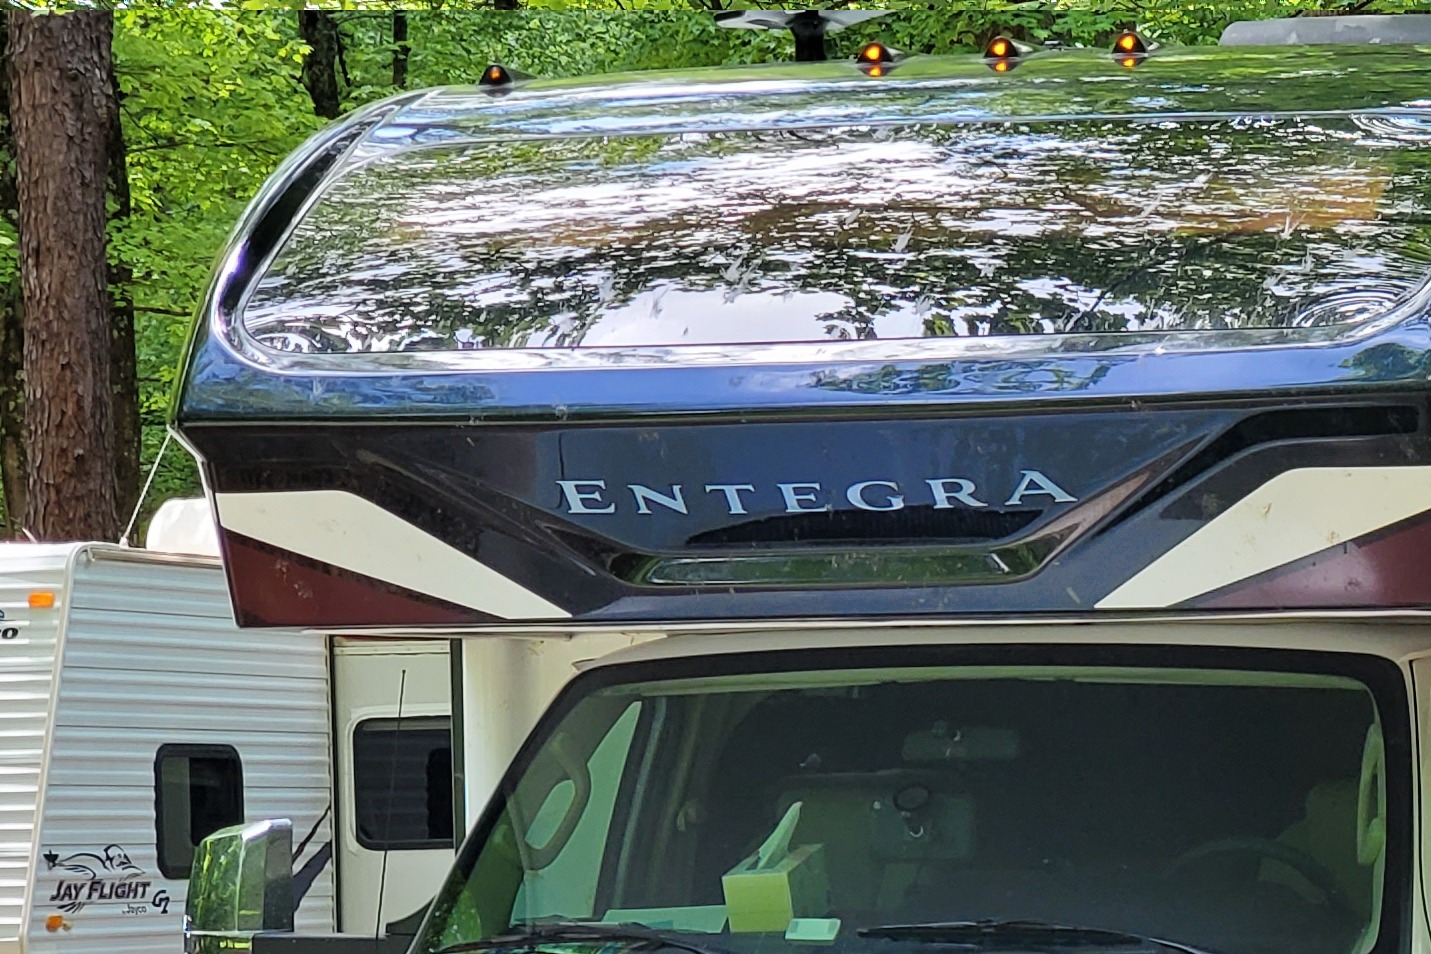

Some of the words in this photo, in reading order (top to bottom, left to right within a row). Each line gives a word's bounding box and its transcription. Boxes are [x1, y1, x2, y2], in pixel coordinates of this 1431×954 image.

[555, 469, 1079, 515] ENTEGRA
[49, 880, 88, 902] JAY
[85, 879, 152, 900] FLIGHT
